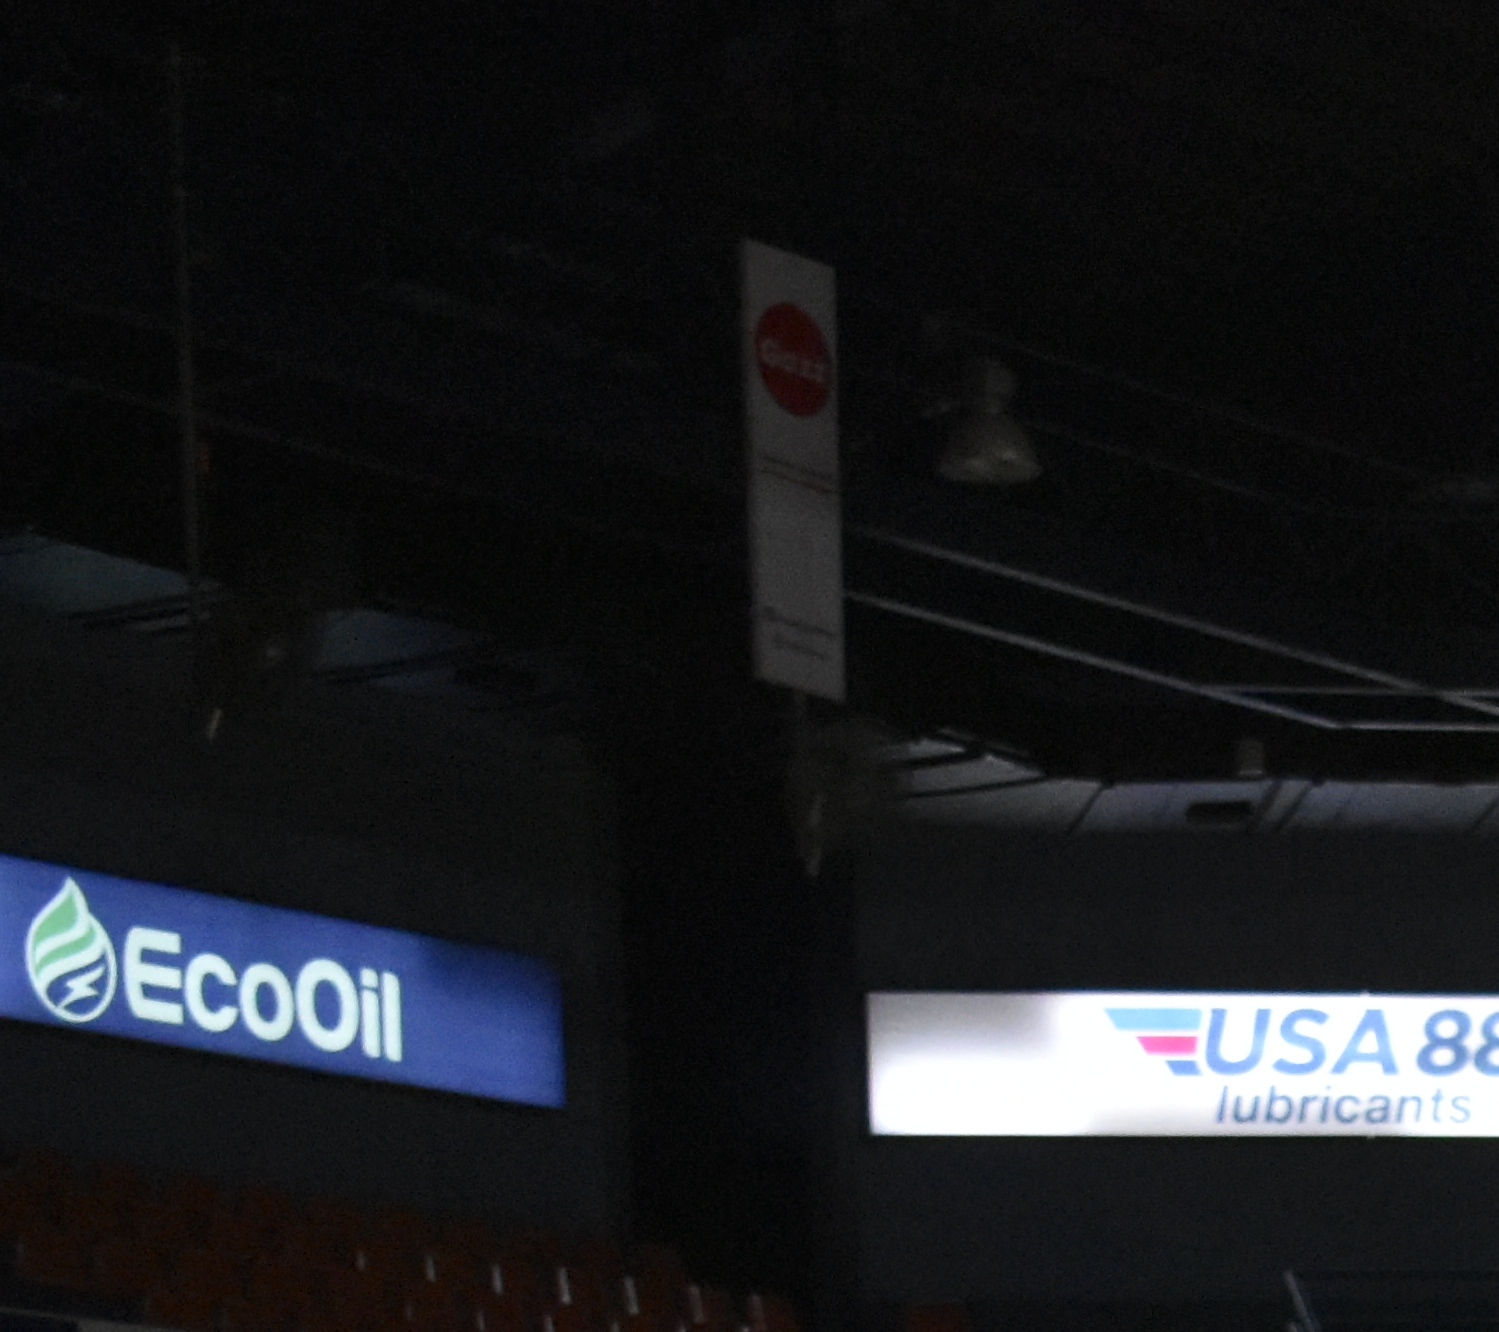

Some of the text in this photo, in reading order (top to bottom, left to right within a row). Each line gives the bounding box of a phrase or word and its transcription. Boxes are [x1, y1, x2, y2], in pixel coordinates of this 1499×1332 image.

[122, 926, 403, 1062] EcoOil
[1205, 1007, 1401, 1076] USA
[1215, 1084, 1474, 1126] lubricants
